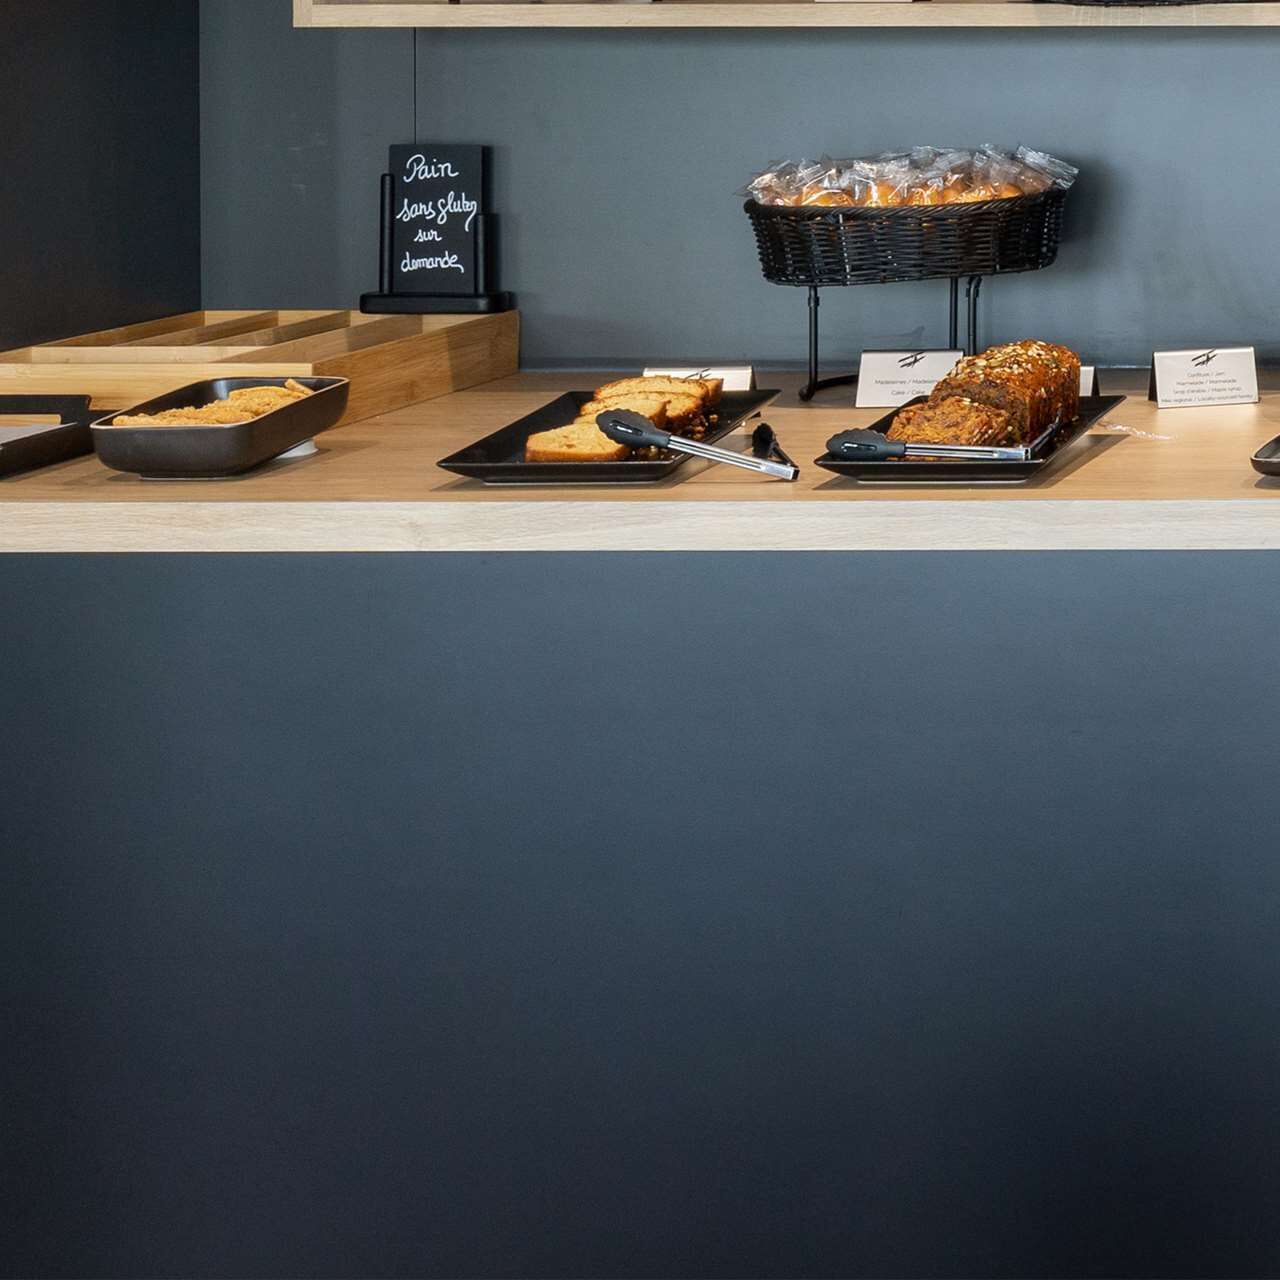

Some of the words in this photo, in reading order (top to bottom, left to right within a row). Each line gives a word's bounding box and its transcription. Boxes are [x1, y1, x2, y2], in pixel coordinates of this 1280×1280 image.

[403, 153, 459, 183] Pain
[395, 198, 436, 222] sans
[413, 228, 443, 242] sur
[400, 250, 465, 274] demande
